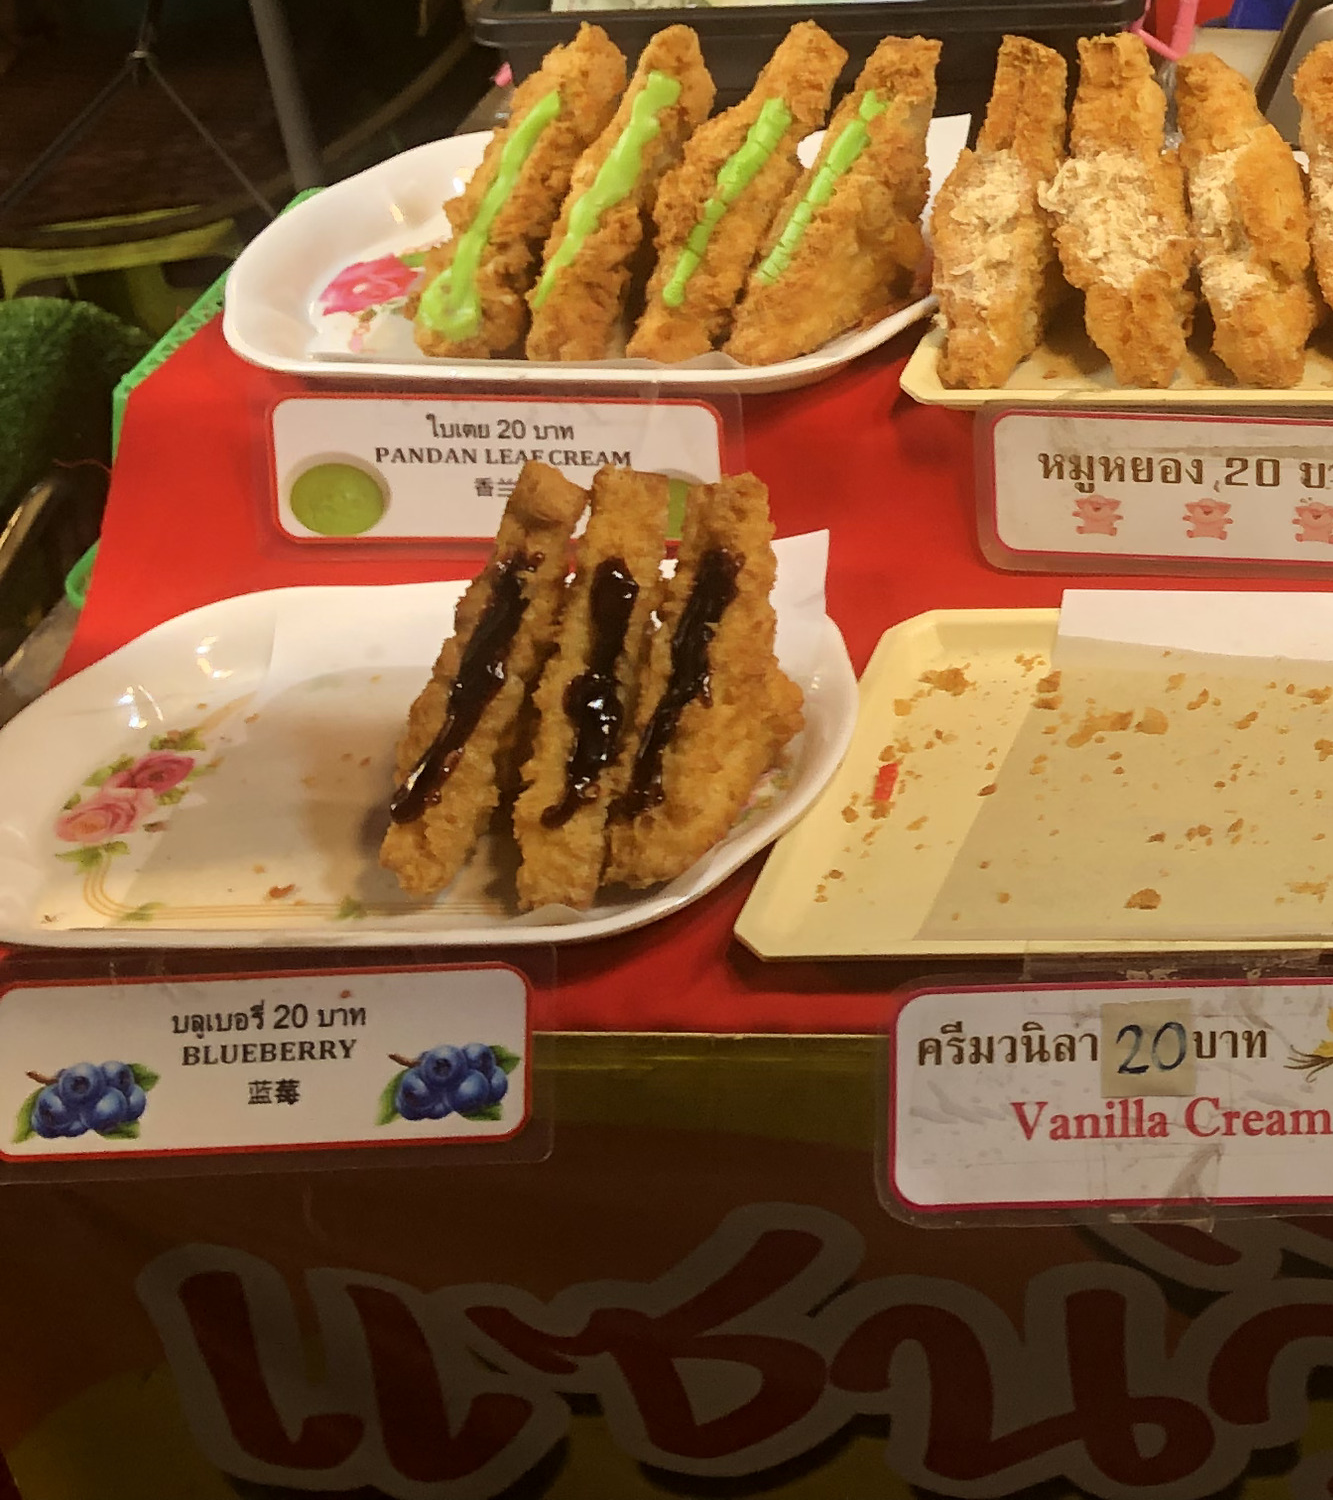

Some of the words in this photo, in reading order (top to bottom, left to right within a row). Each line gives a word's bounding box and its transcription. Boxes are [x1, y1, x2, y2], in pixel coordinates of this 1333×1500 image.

[425, 413, 491, 440] ใบเตย
[497, 418, 527, 440] 20
[533, 423, 575, 440] บาท
[374, 446, 478, 465] PANDAN
[486, 448, 545, 465] LEAF
[549, 450, 633, 467] CREAM
[1037, 450, 1205, 494] หมูหยอง
[1224, 456, 1281, 487] 20
[273, 1003, 309, 1030] 20
[317, 1006, 367, 1028] บาท
[181, 1039, 357, 1066] BLUEBERRY
[917, 1020, 1099, 1067] ครีมวนิลา
[1115, 1021, 1188, 1075] 20
[1192, 1029, 1268, 1059] บาท
[247, 1078, 300, 1106] 蓝莓
[1010, 1098, 1170, 1141] Vanilla
[1184, 1096, 1333, 1138] Cream
